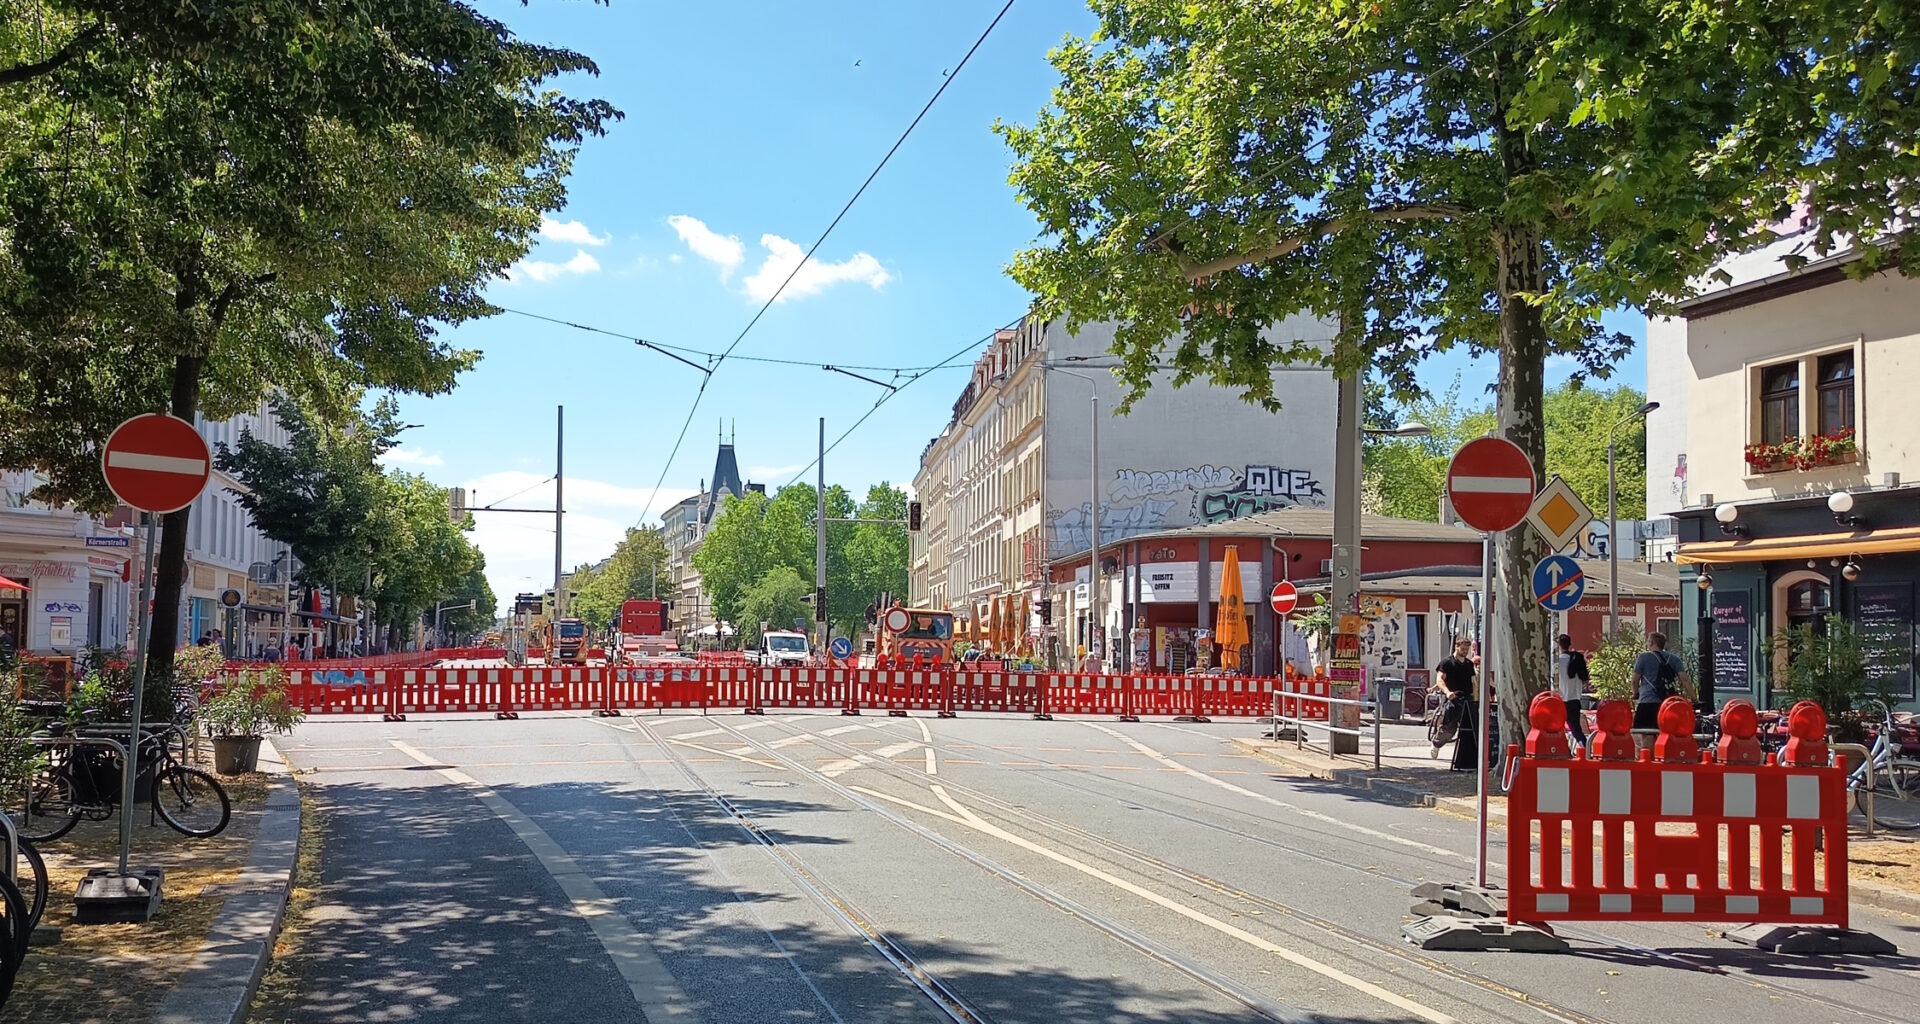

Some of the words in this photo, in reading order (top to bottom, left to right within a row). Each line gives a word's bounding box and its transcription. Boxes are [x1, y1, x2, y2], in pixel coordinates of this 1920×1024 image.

[1246, 465, 1313, 497] QUE
[88, 538, 126, 546] Körnerstraße
[1152, 573, 1174, 581] FREISITZ
[1713, 606, 1734, 616] Burger
[1735, 605, 1743, 614] of
